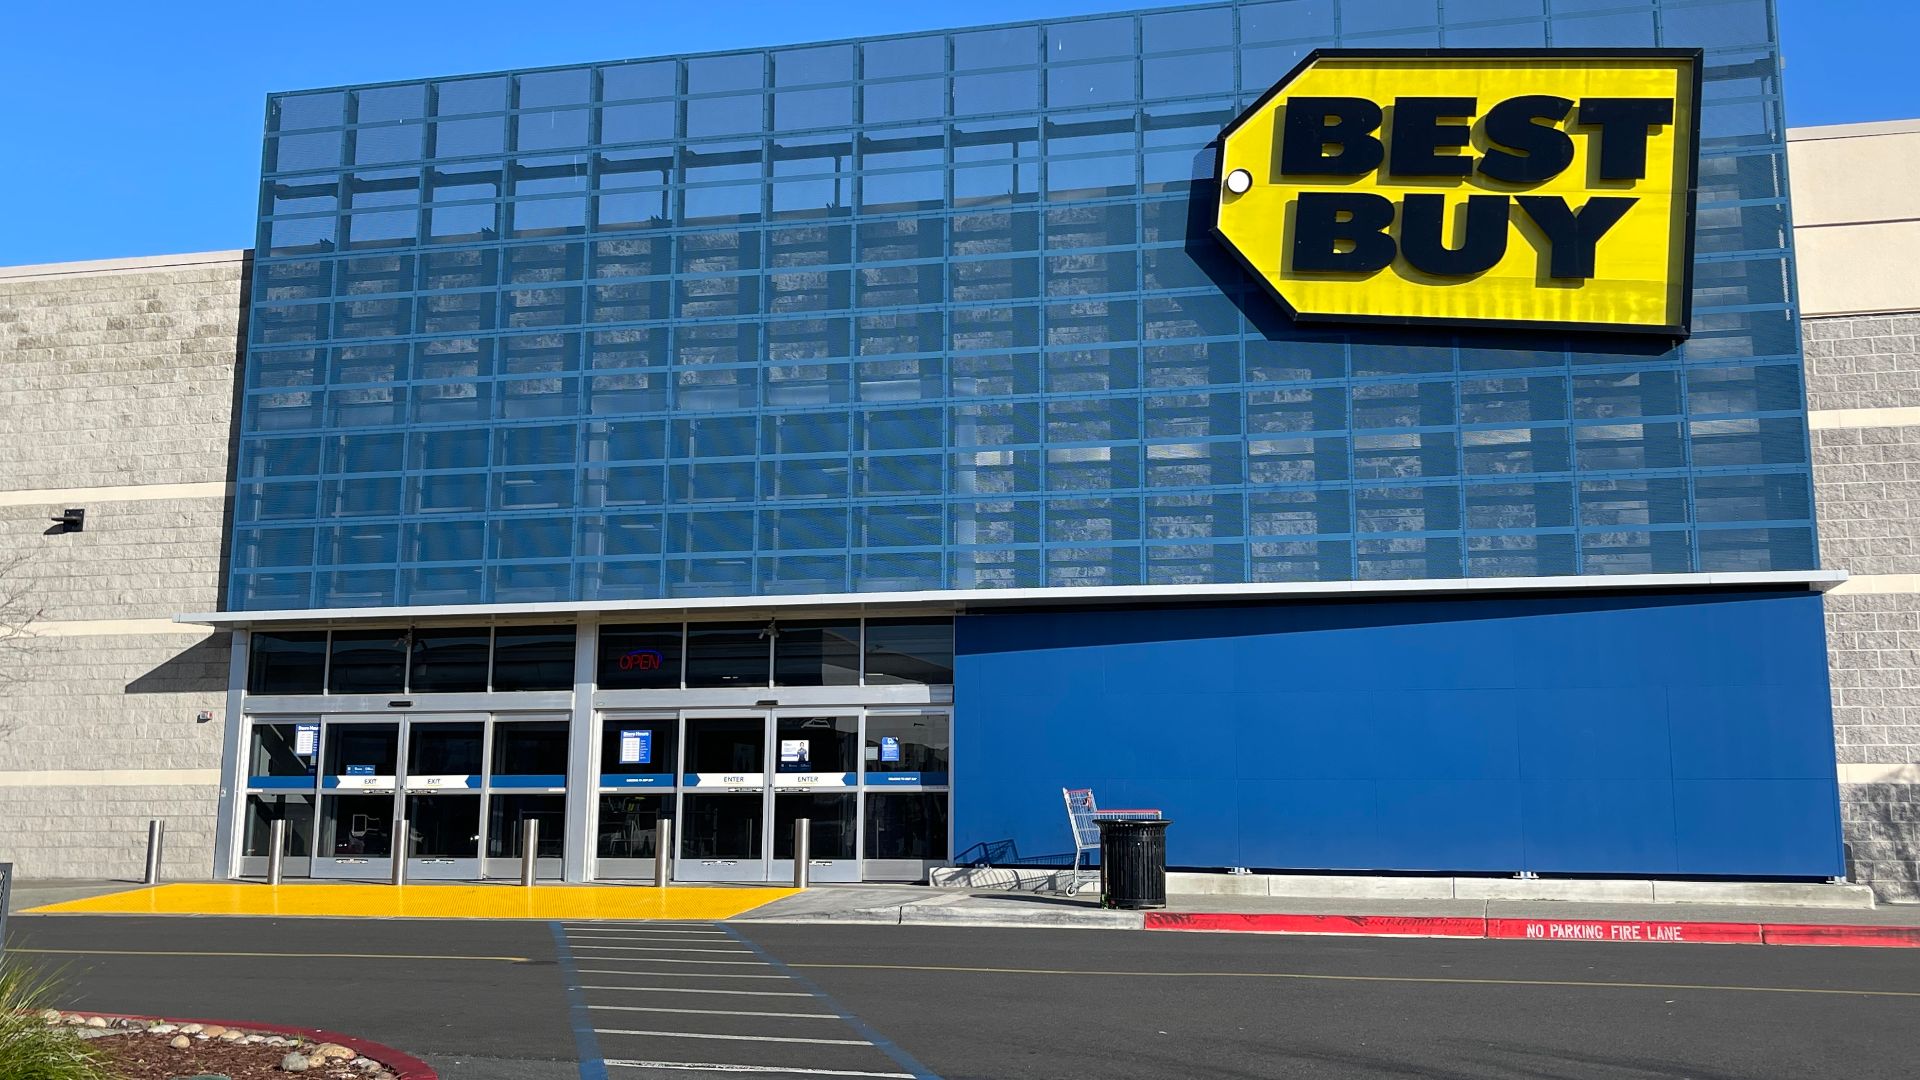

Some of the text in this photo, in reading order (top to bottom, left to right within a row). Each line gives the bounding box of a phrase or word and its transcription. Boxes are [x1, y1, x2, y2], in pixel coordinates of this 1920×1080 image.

[1281, 94, 1674, 182] BEST
[1292, 191, 1641, 279] BUY
[619, 654, 660, 670] OPEN
[1526, 924, 1683, 940] NO PARKING FIRE LANE
